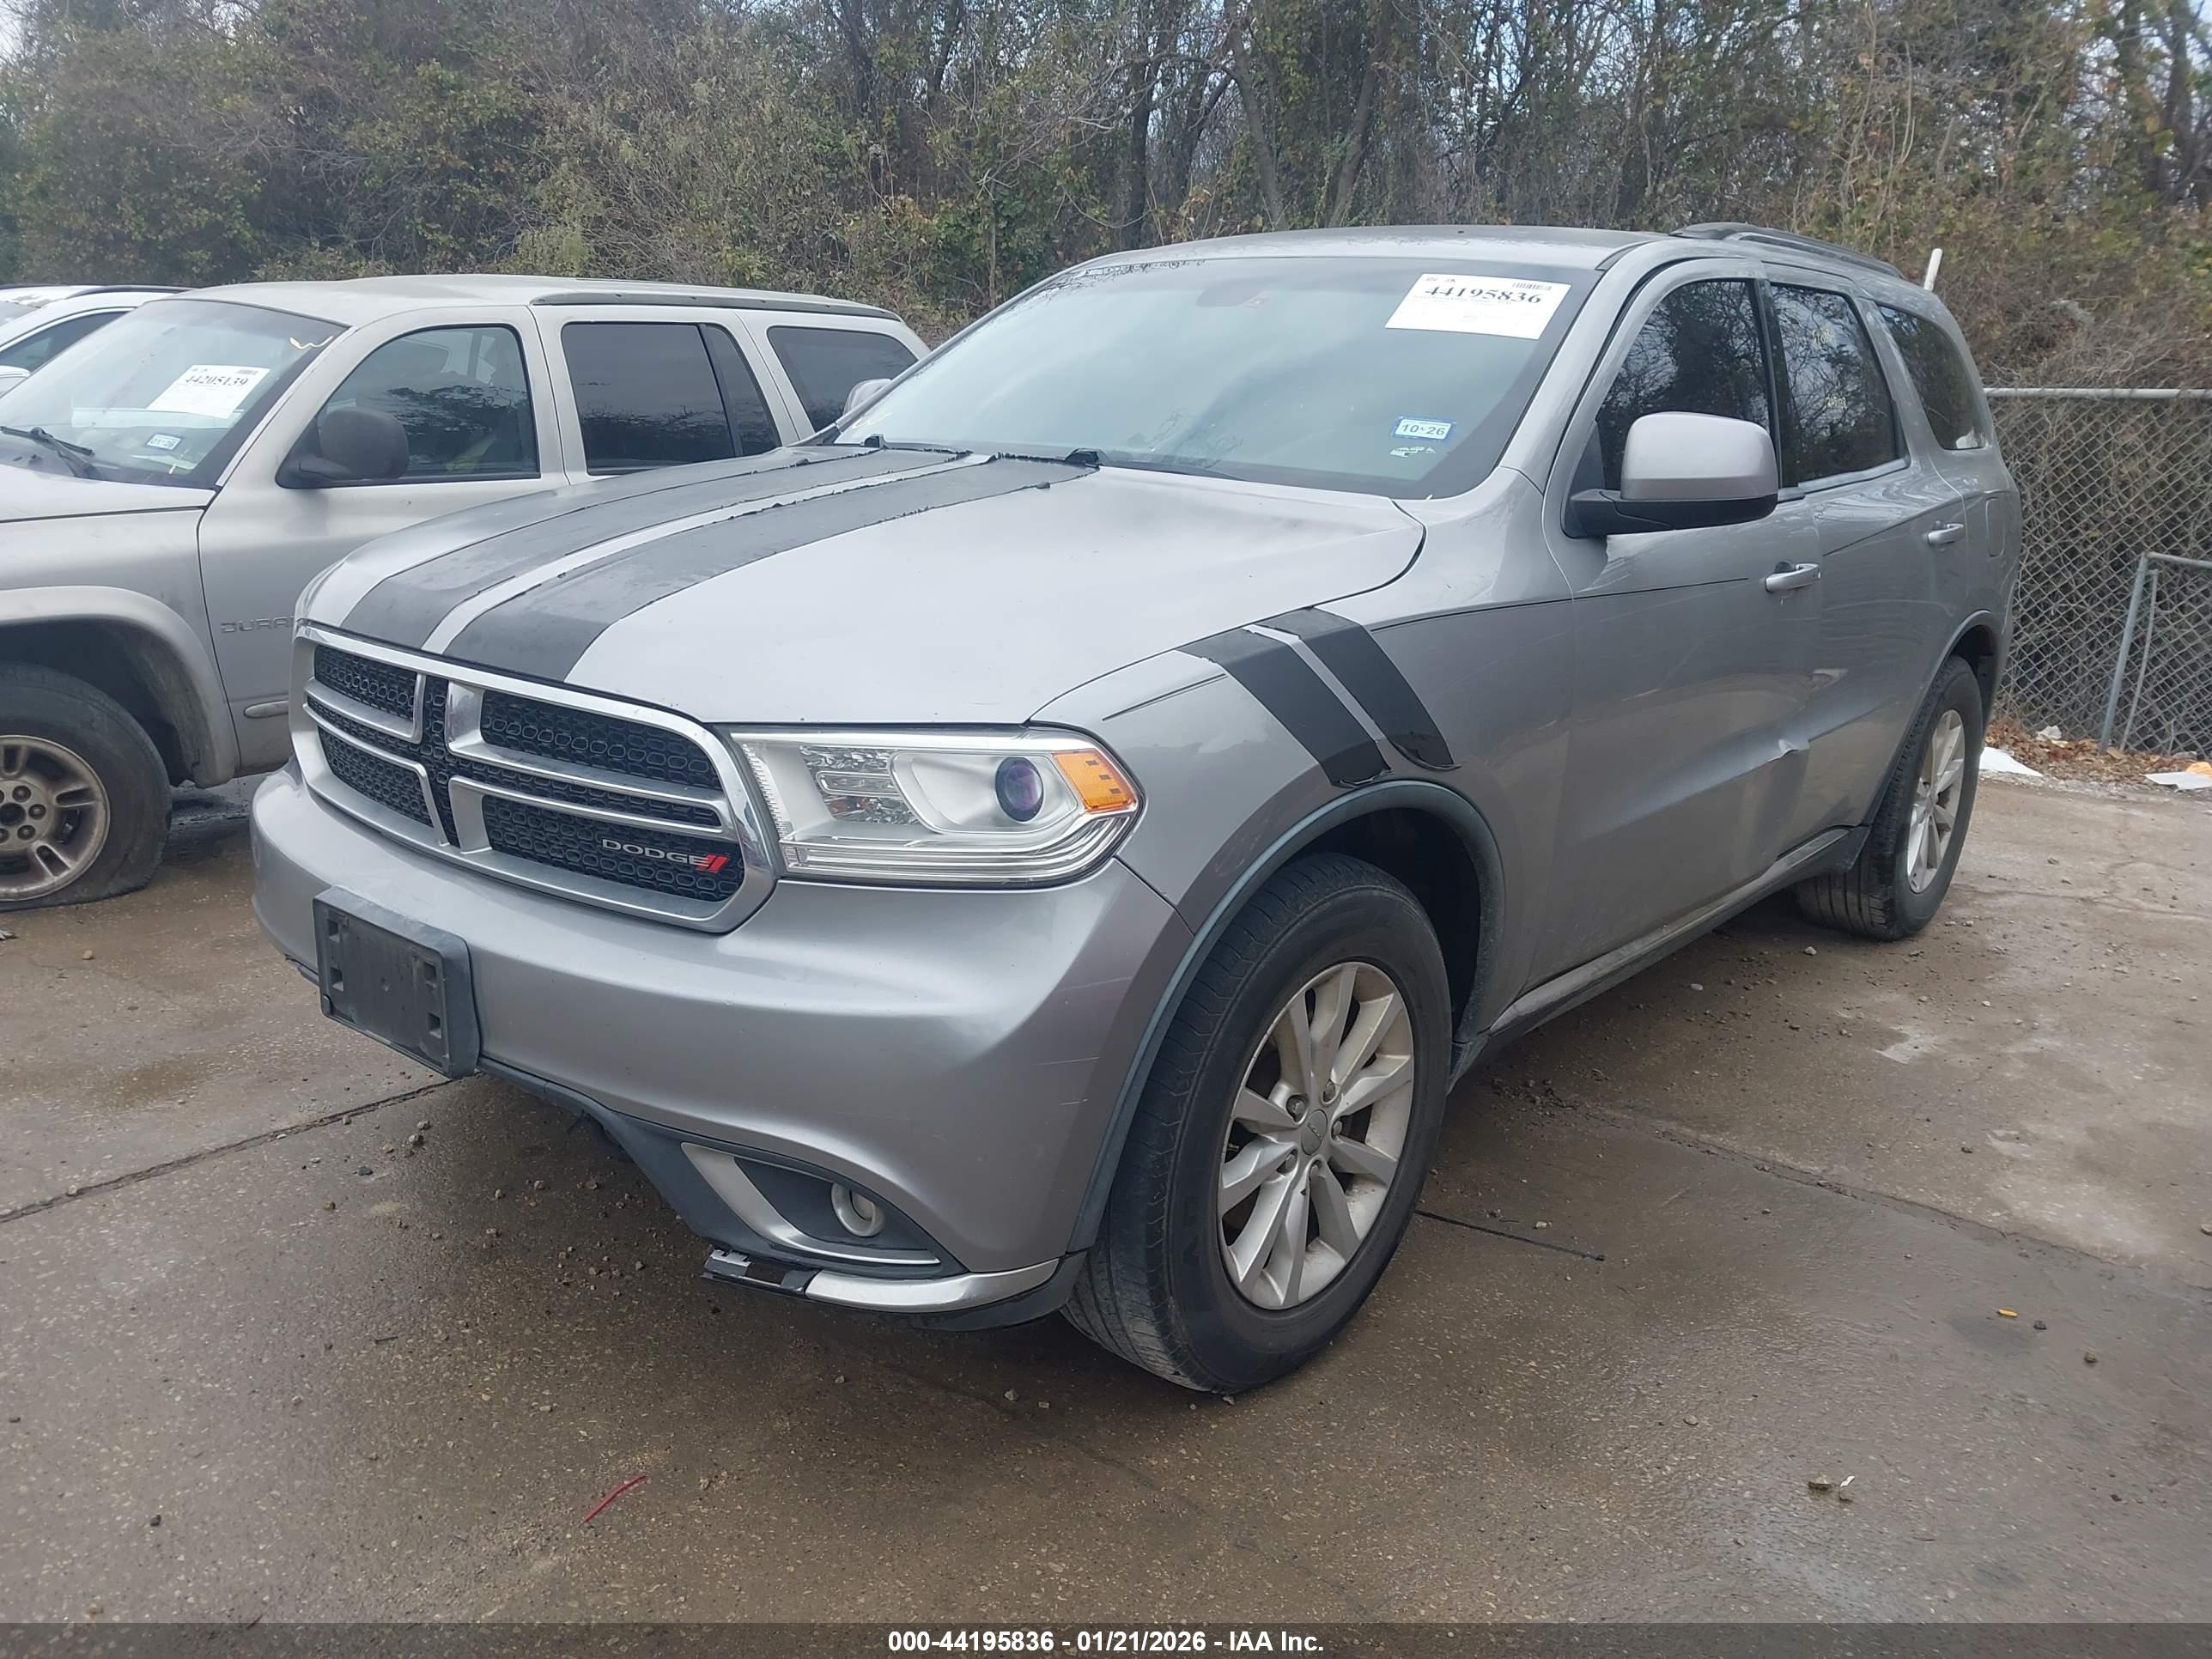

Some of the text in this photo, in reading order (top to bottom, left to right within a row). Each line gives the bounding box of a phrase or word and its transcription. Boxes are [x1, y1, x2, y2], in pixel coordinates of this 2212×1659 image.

[1425, 285, 1544, 305] 44195836
[185, 374, 249, 387] 44205139
[221, 616, 295, 633] DURA
[602, 838, 710, 867] DODGE
